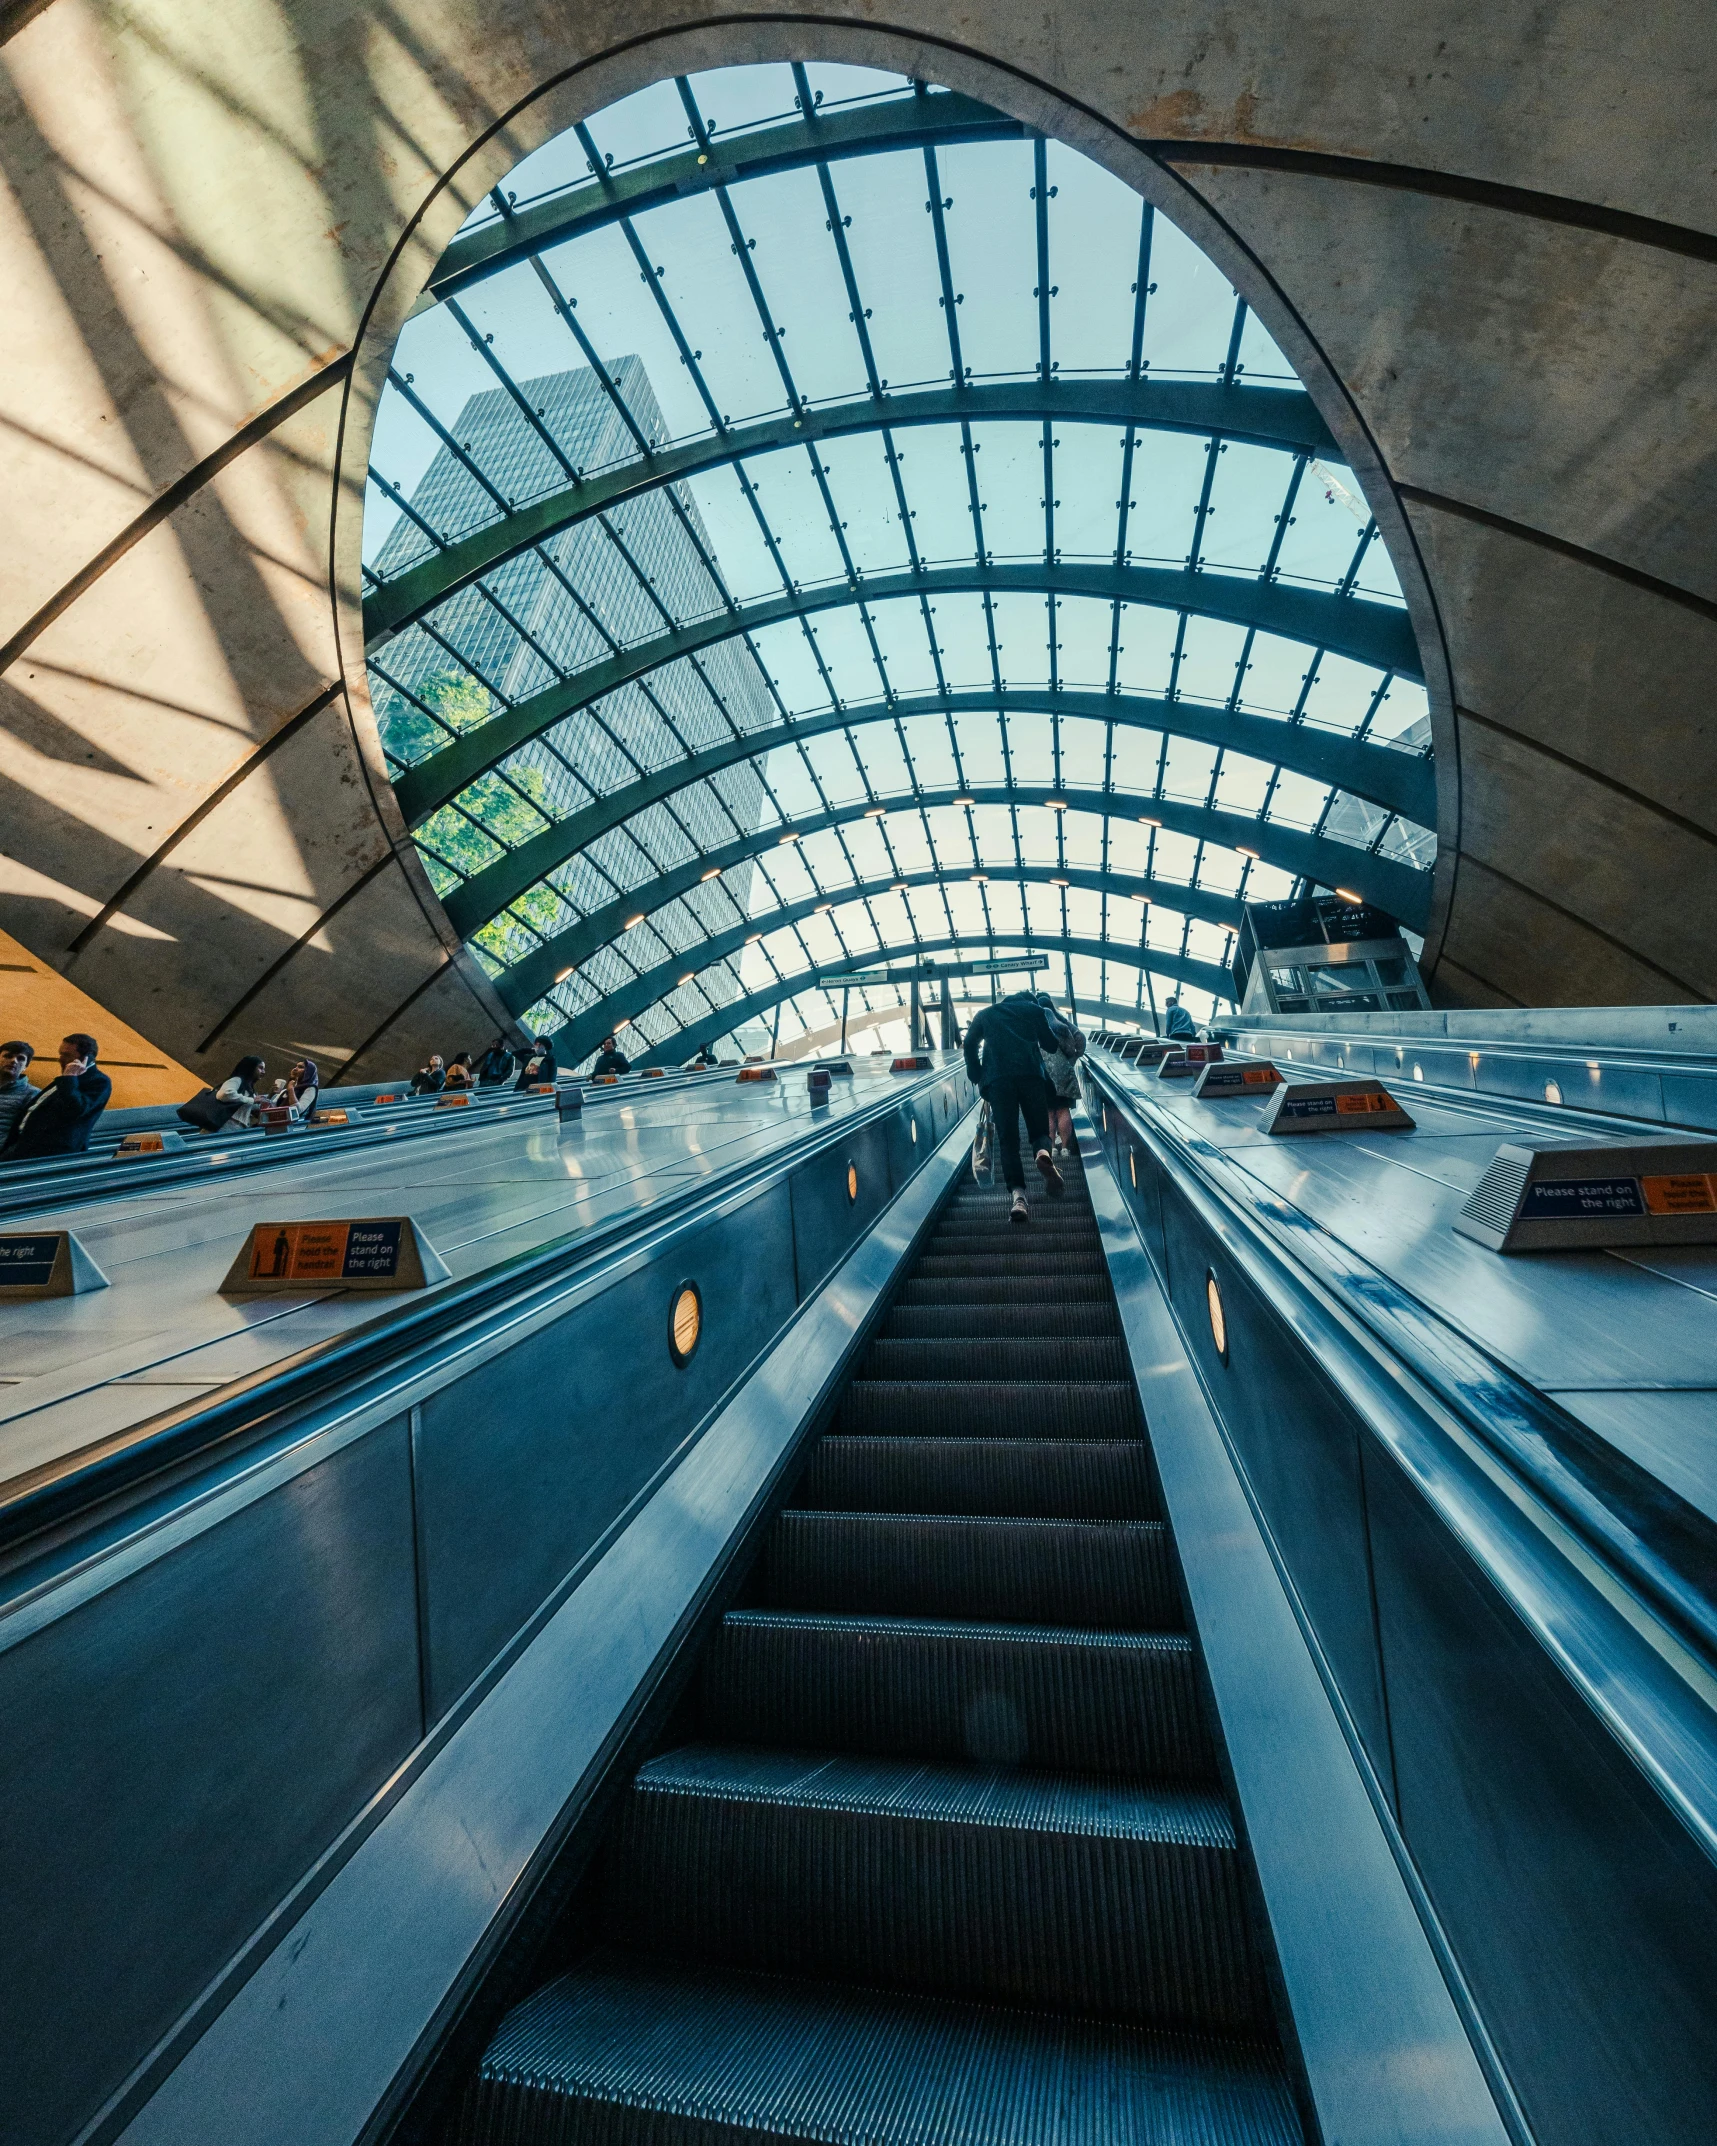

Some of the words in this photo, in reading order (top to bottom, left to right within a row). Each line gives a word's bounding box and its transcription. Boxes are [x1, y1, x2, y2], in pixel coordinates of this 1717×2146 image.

[1535, 1187, 1576, 1198] Please
[1578, 1186, 1613, 1196] stand
[1616, 1186, 1632, 1195] on
[1581, 1198, 1603, 1208] the
[1606, 1198, 1636, 1210] right
[301, 1234, 332, 1244] Please
[352, 1232, 384, 1242] Please
[0, 1246, 11, 1256] he
[12, 1246, 36, 1259] right
[300, 1246, 321, 1256] hold
[323, 1246, 338, 1256] the
[350, 1244, 378, 1255] stand
[380, 1246, 393, 1254] on
[298, 1260, 336, 1270] handrail
[348, 1258, 366, 1268] the
[367, 1257, 392, 1270] right
